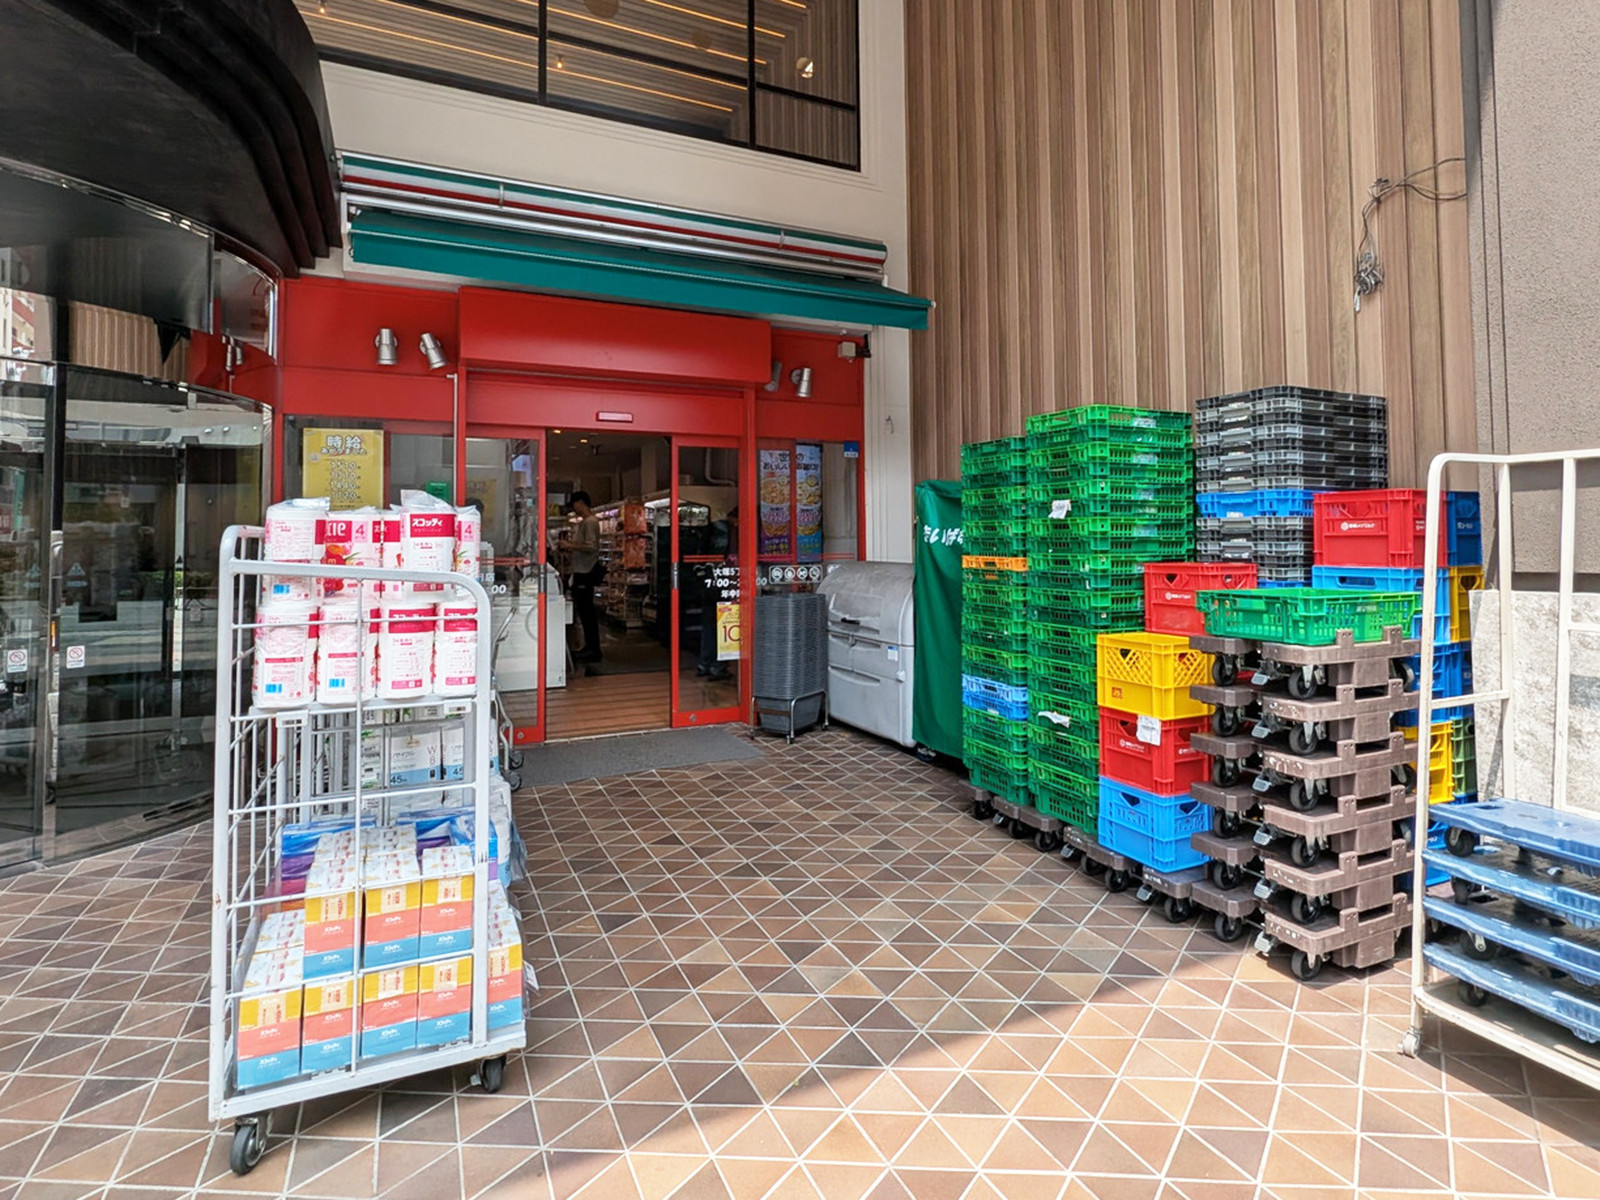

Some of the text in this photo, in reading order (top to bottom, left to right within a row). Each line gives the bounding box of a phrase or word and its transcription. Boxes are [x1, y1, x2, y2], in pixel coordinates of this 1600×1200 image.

[326, 435, 362, 450] 時給
[412, 517, 444, 527] スコッティ
[355, 524, 365, 536] 4
[464, 525, 473, 536] 4
